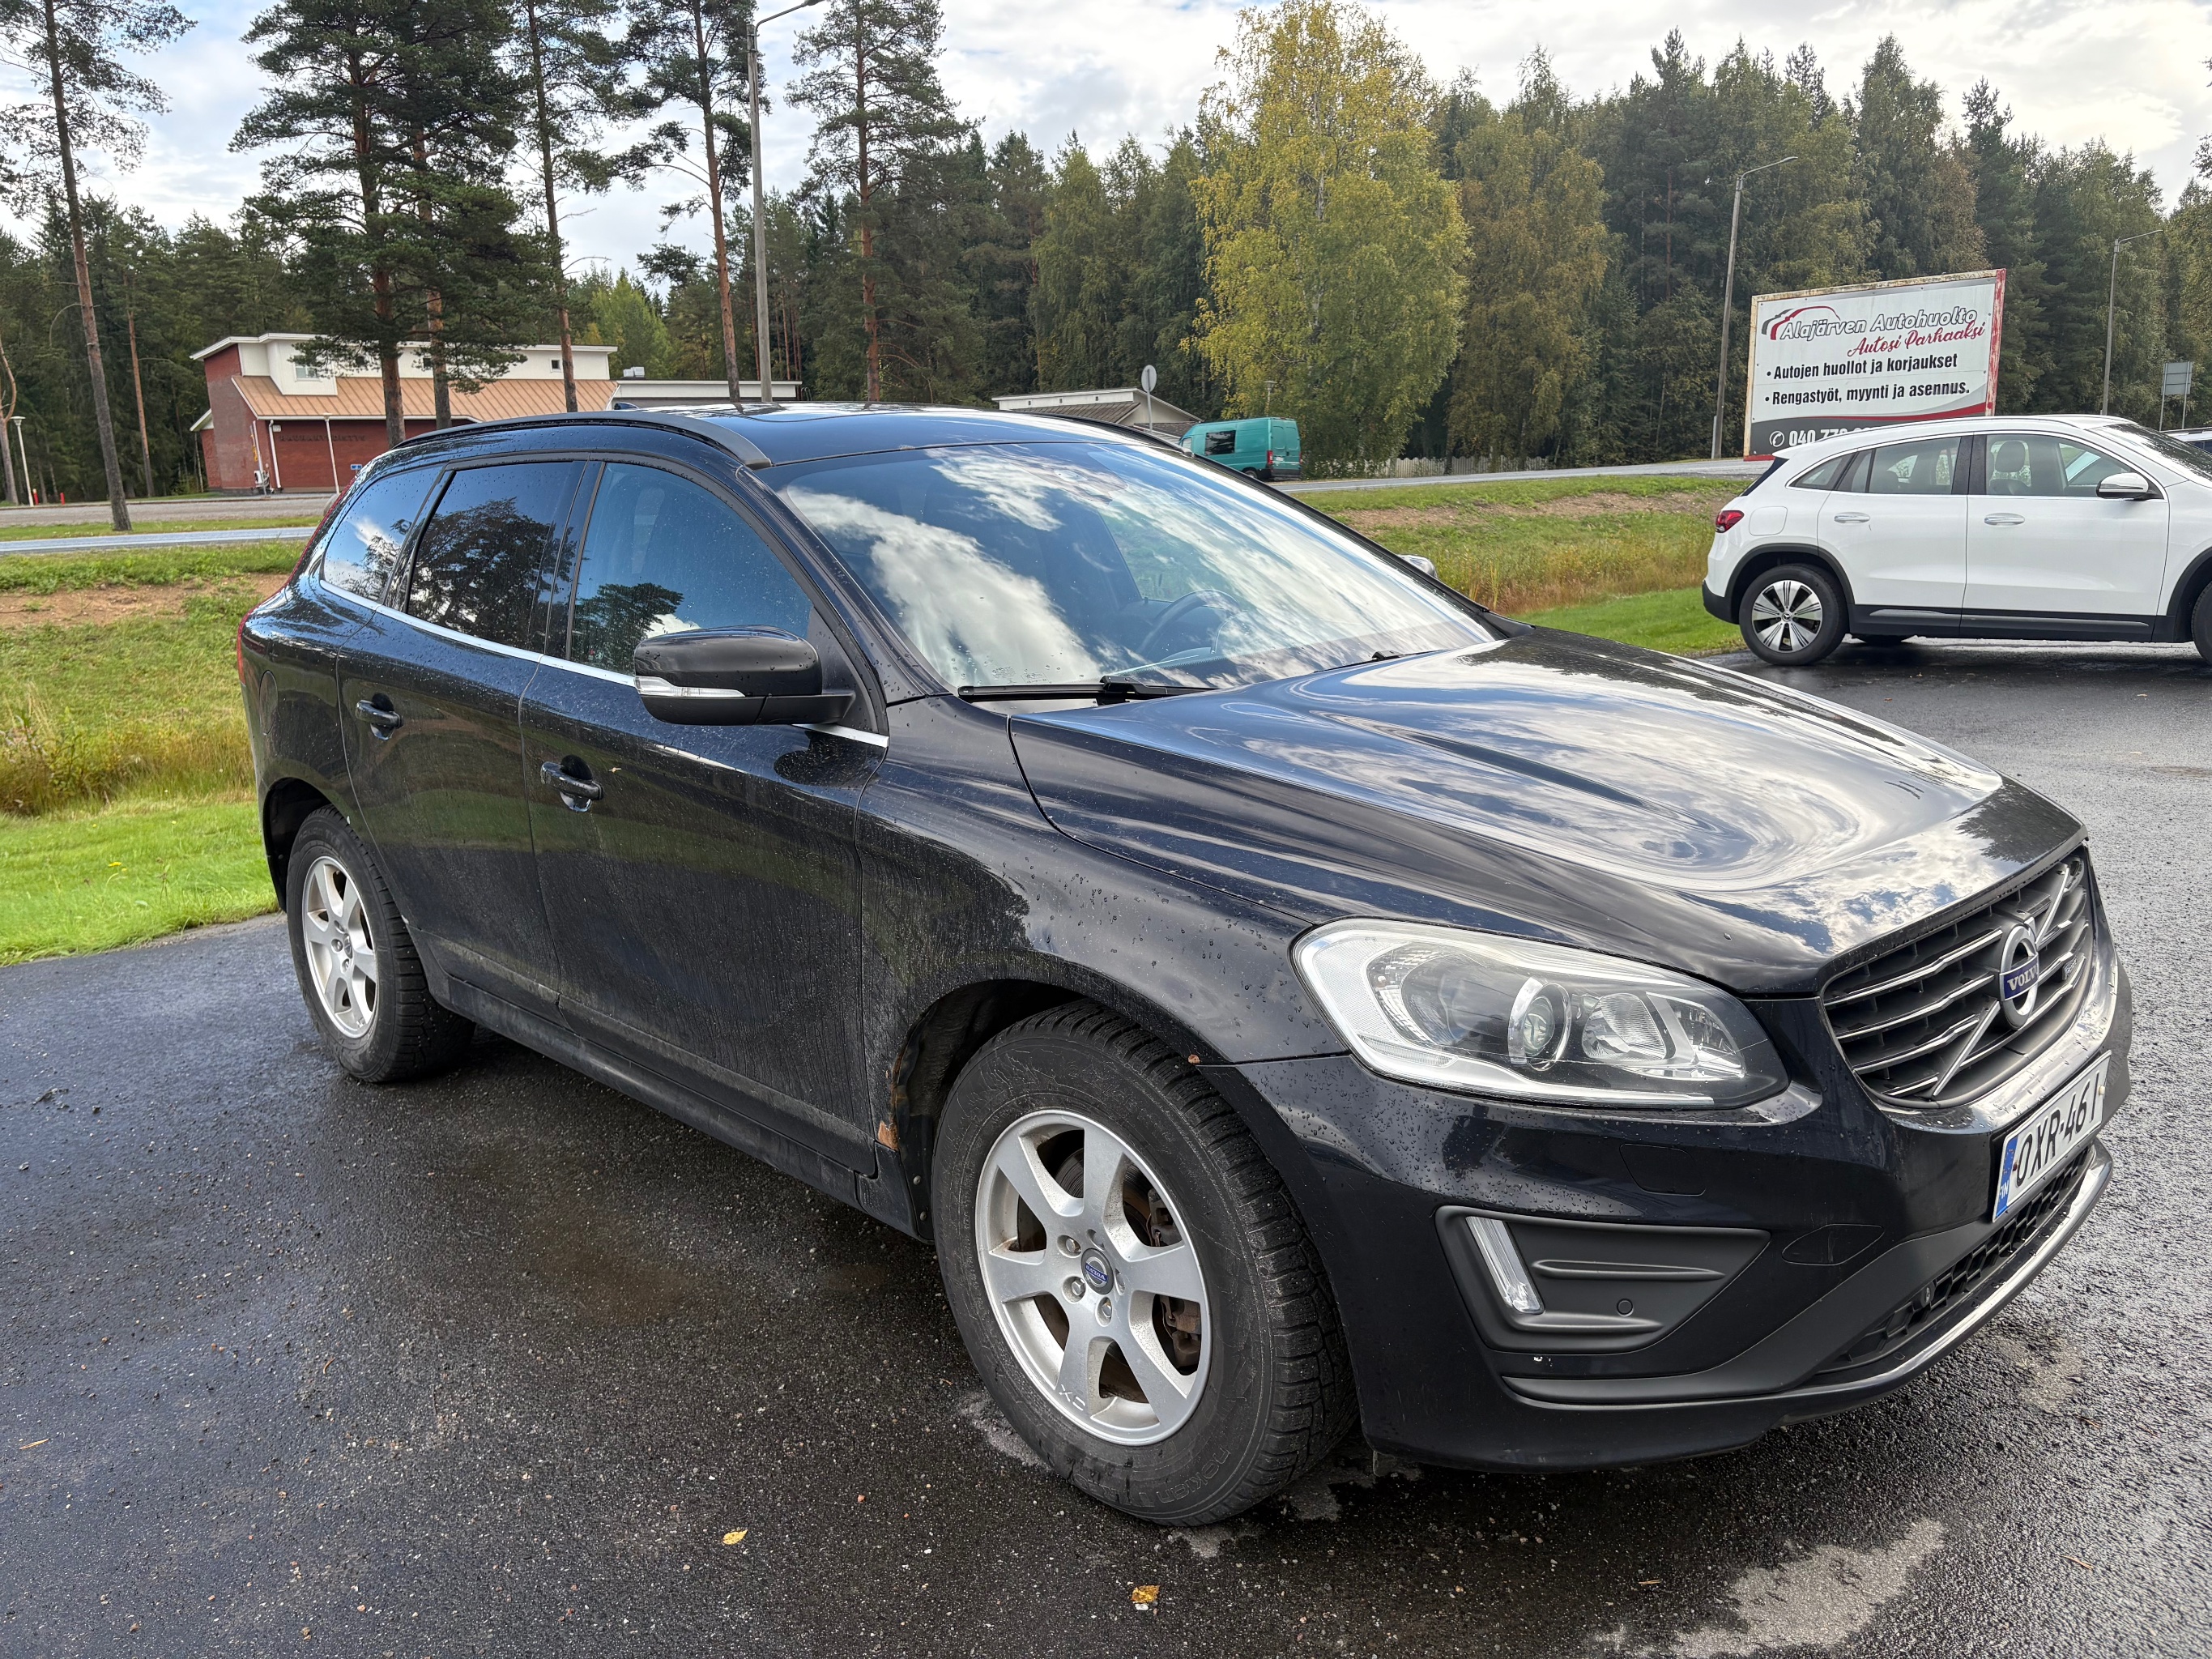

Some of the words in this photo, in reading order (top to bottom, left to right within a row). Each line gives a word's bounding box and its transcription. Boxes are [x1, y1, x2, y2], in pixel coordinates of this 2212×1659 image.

[1780, 319, 1867, 341] Alajärven
[1870, 306, 1977, 331] Autohuolto
[1848, 335, 1902, 356] Autosi
[1904, 321, 1985, 349] Parhaaksi
[1774, 365, 1819, 379] Autojen
[1823, 359, 1867, 376] huollot
[1870, 359, 1882, 374] ja
[1887, 353, 1957, 372] korjaukset
[1772, 387, 1842, 405] Rengastyöt,
[1847, 385, 1889, 401] myynti
[1892, 384, 1905, 399] ja
[1909, 382, 1969, 397] asennus.
[1789, 430, 1816, 446] 040
[2017, 1071, 2099, 1188] OXR-461
